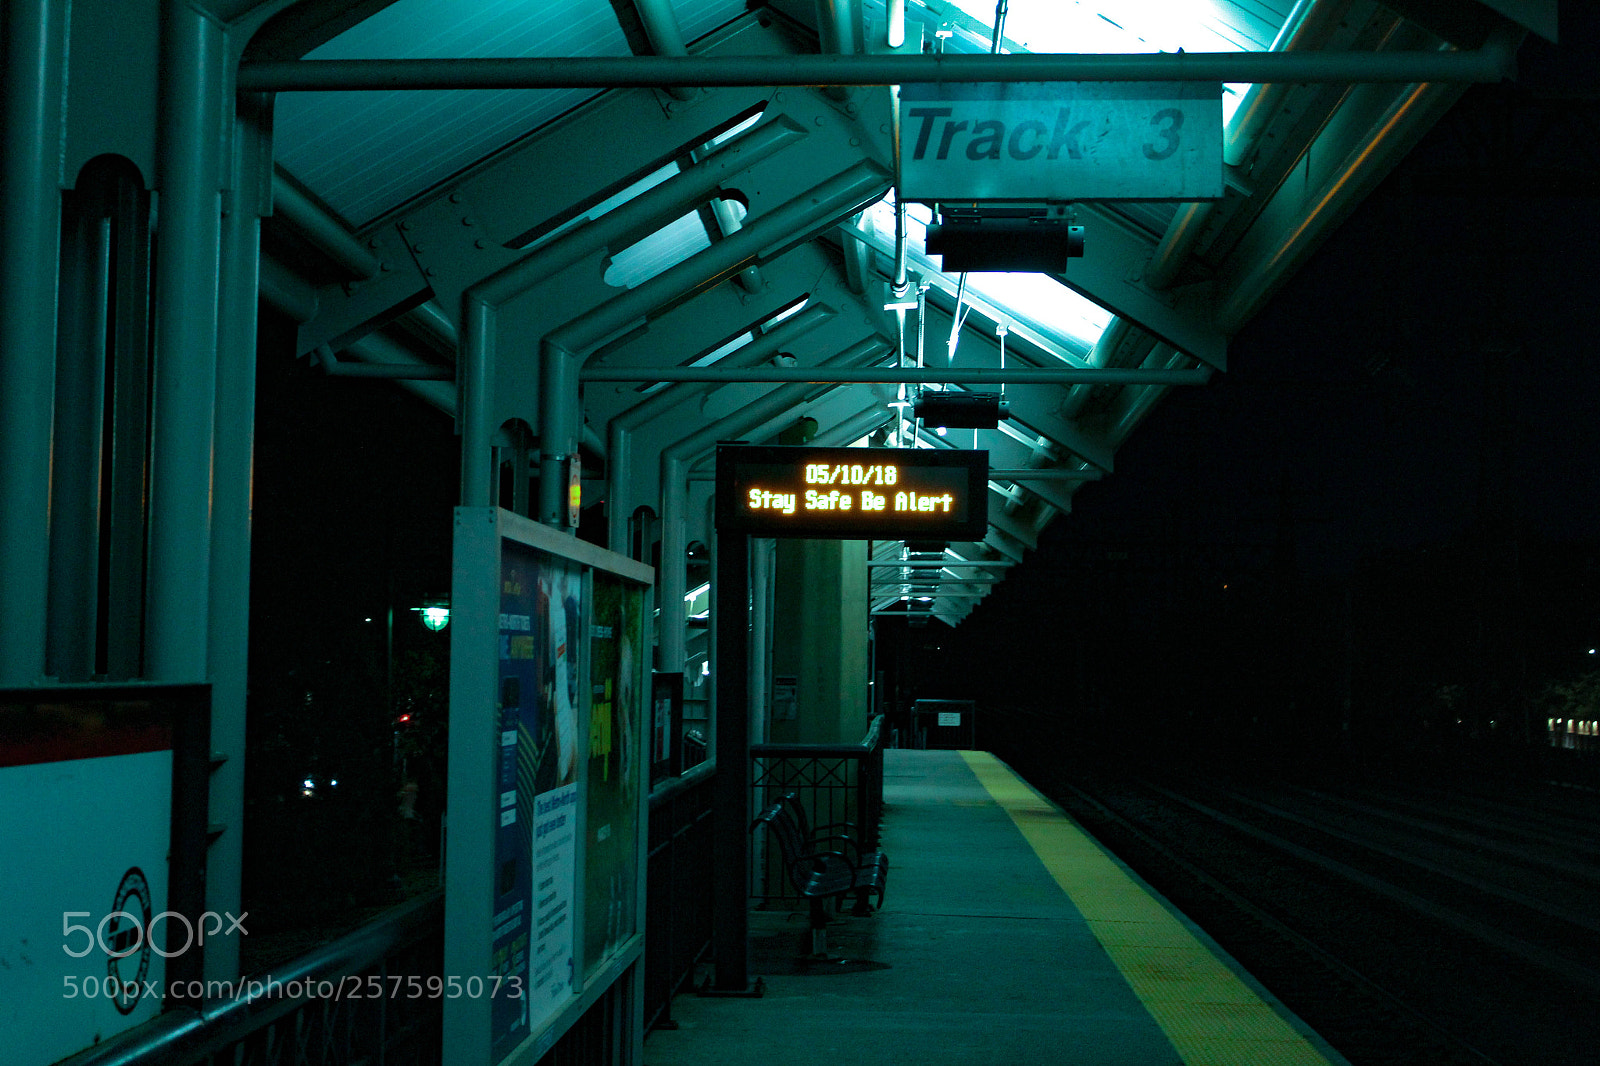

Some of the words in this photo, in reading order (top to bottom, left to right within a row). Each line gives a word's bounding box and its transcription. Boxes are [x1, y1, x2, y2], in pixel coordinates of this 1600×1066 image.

[908, 106, 1092, 162] Track
[1141, 107, 1186, 162] 3
[804, 463, 898, 486] 05/10/18
[748, 488, 797, 515] Stay
[804, 489, 852, 512] Safe
[861, 490, 886, 512] Be
[894, 491, 954, 513] Alert
